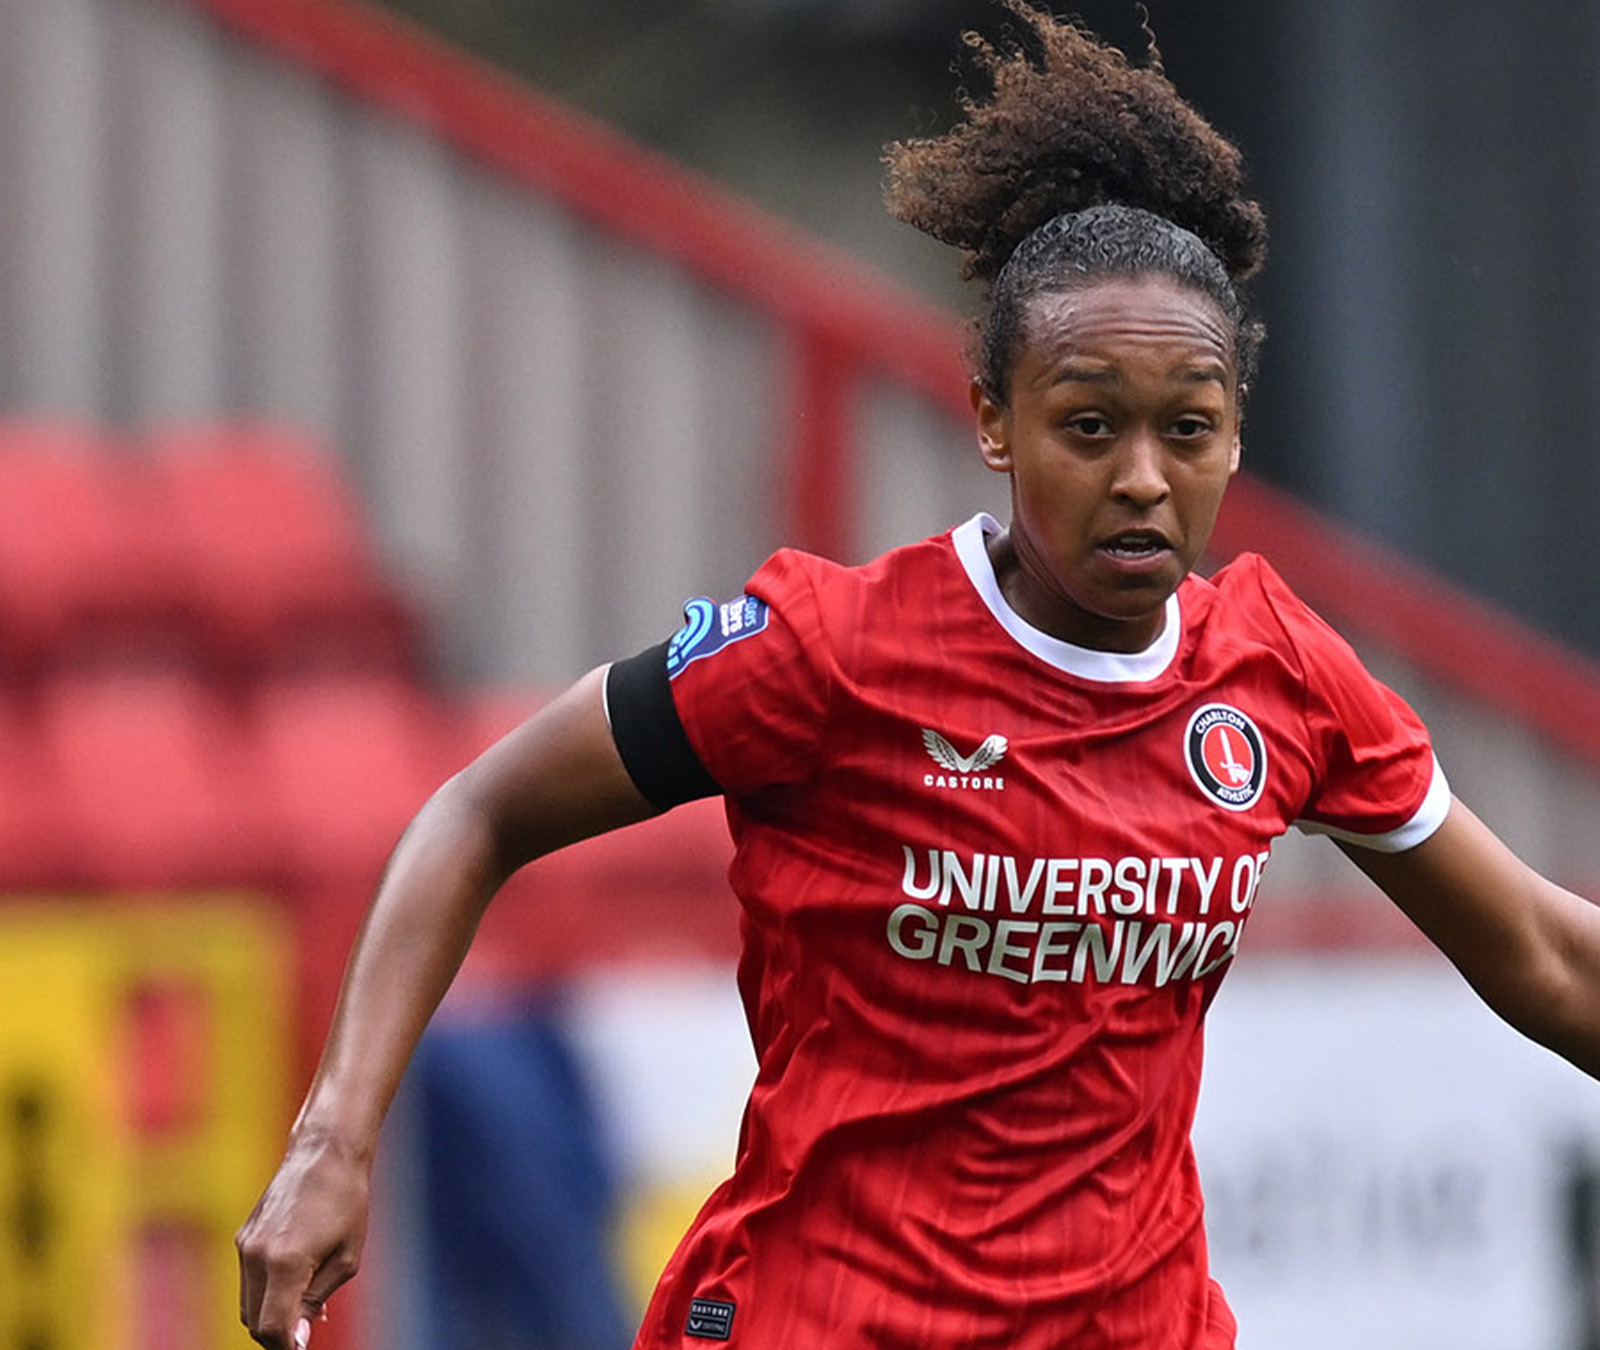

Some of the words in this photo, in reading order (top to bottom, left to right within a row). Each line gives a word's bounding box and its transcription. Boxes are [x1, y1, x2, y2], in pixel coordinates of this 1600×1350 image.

[1194, 710, 1246, 734] CHARLTON
[923, 774, 1005, 791] CASTORE
[901, 845, 1223, 915] UNIVERSITY
